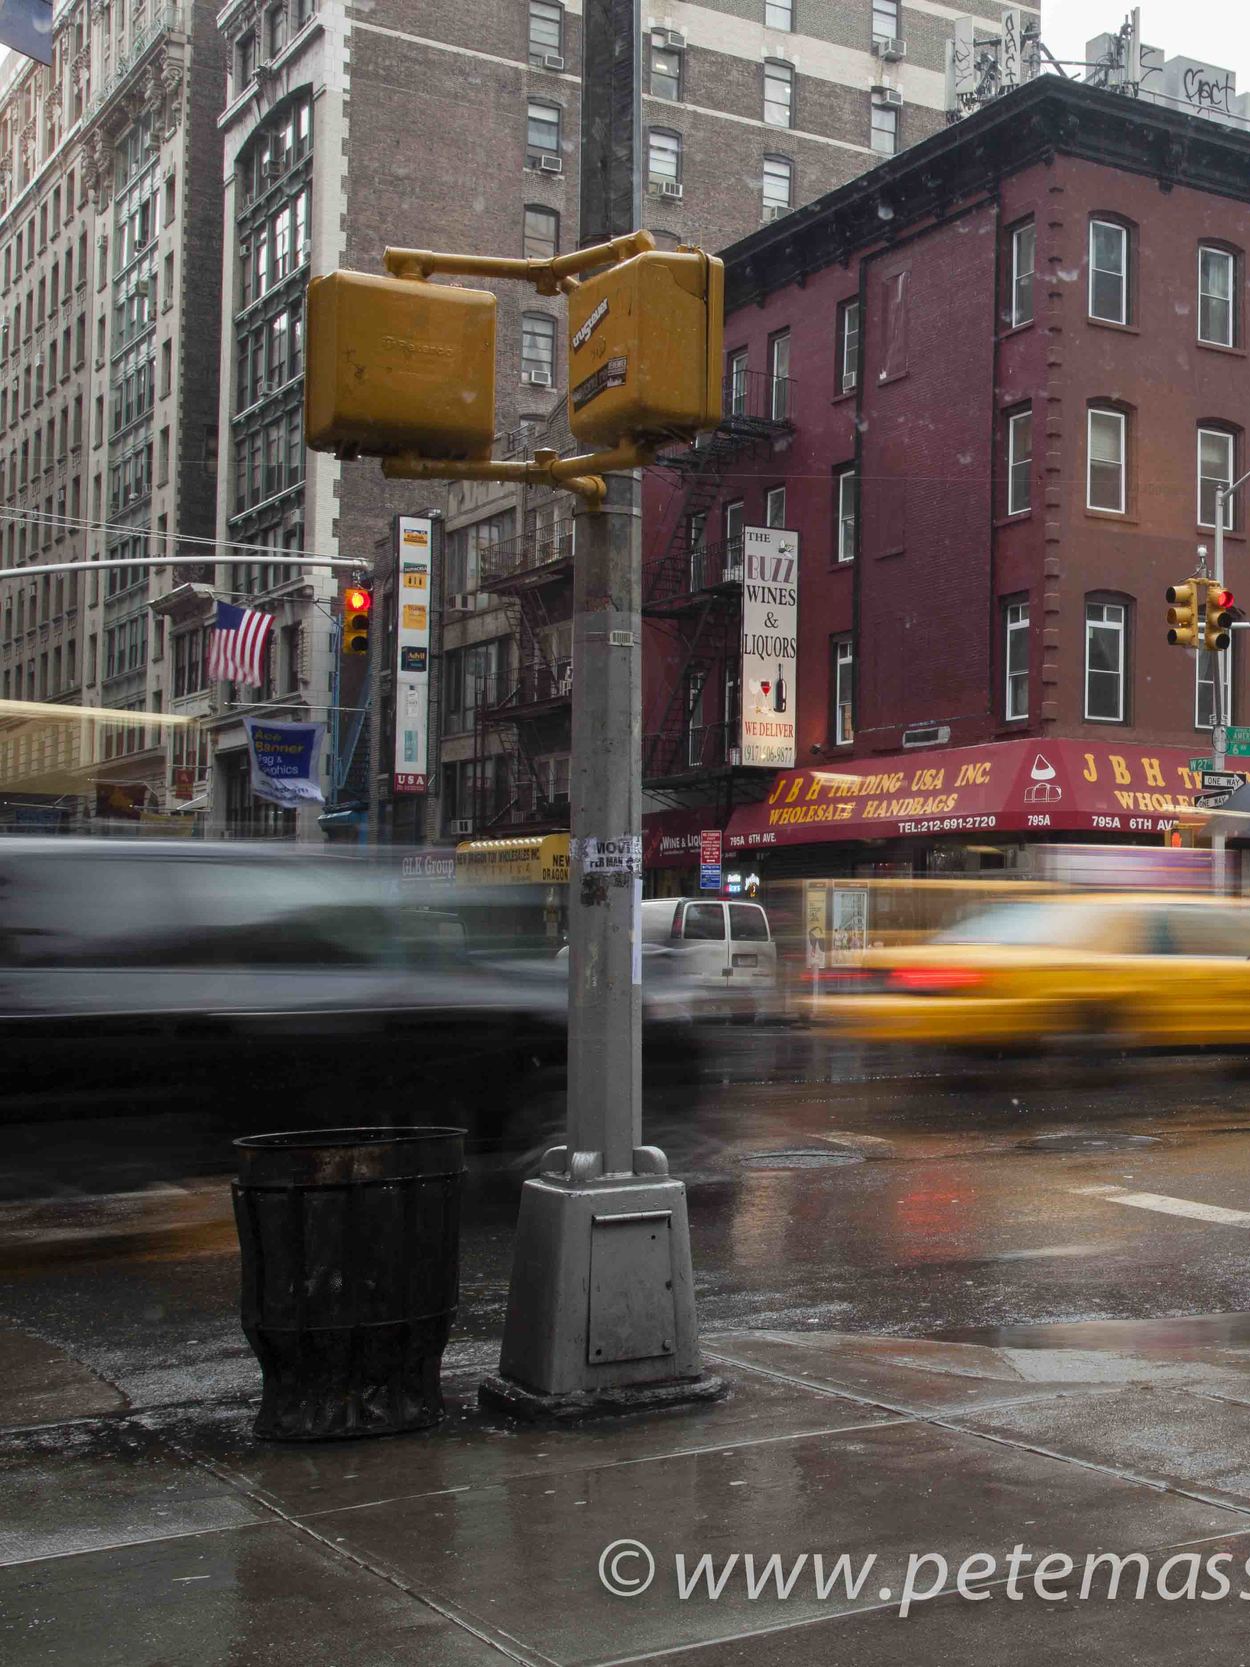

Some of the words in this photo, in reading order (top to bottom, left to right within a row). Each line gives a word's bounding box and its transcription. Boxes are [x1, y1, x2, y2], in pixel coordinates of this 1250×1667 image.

[747, 531, 771, 543] THE
[747, 555, 794, 584] BUZZ
[746, 585, 796, 606] WINES
[764, 611, 779, 629] &
[744, 634, 796, 660] LIQUORS
[745, 722, 758, 736] WE
[760, 722, 794, 738] DELIVER
[255, 741, 304, 753] Banner
[1232, 746, 1239, 754] 6
[1083, 753, 1097, 782] J
[1109, 755, 1131, 785] B
[1141, 757, 1166, 787] H
[1190, 760, 1197, 770] W
[1199, 760, 1208, 769] 27
[398, 775, 424, 784] USA
[769, 780, 785, 804] J
[786, 778, 803, 804] B
[911, 768, 945, 792] USA
[1207, 777, 1221, 785] ONE
[1226, 778, 1240, 786] WAY
[769, 801, 856, 826] WHOLESALE
[862, 794, 958, 819] HANDBAGS
[898, 816, 996, 834] TEL:212-691-2720
[1028, 815, 1050, 826] 795A
[1092, 816, 1120, 828] 795A
[1129, 817, 1151, 830] 6TH
[681, 838, 686, 847] &
[730, 837, 744, 846] 795A
[749, 835, 760, 844] 6TH
[543, 867, 569, 880] DRAGON
